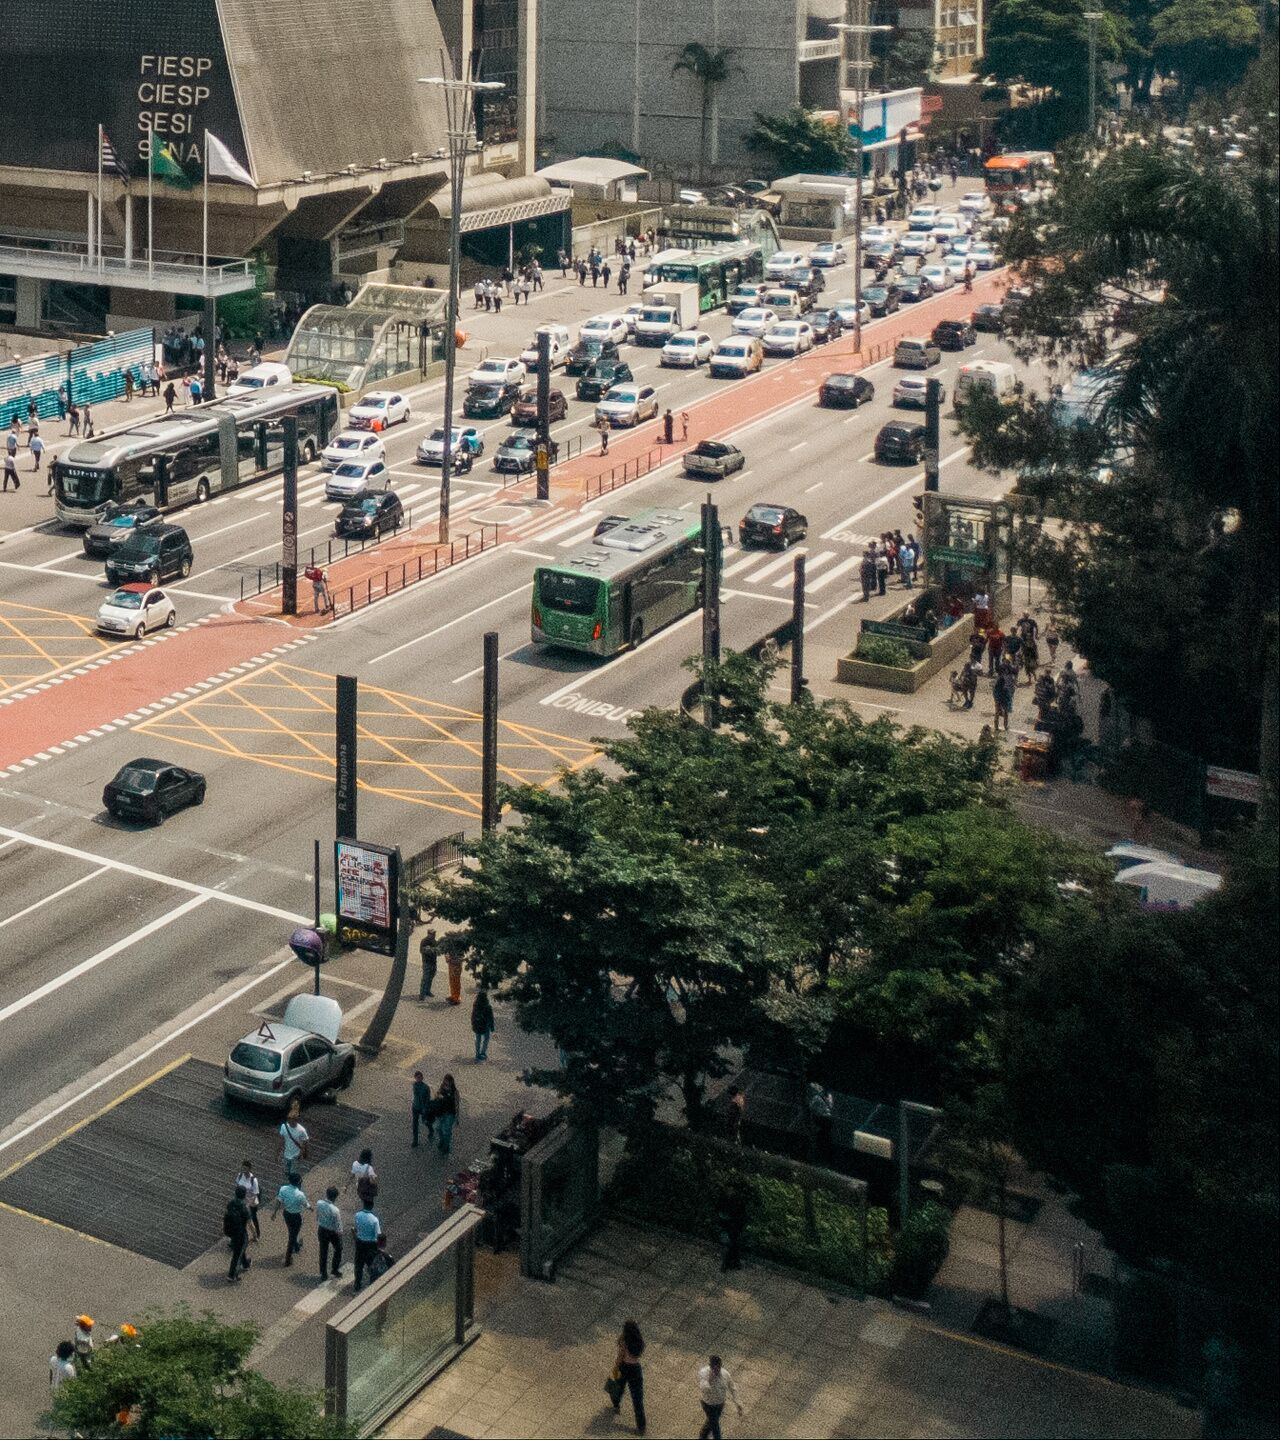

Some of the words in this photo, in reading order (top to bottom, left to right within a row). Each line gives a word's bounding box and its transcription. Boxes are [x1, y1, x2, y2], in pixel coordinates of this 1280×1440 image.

[140, 55, 212, 78] FIESP
[137, 82, 210, 106] CIESP
[137, 111, 192, 134] SESI
[138, 139, 205, 164] SNA
[338, 743, 349, 799] Pamplona
